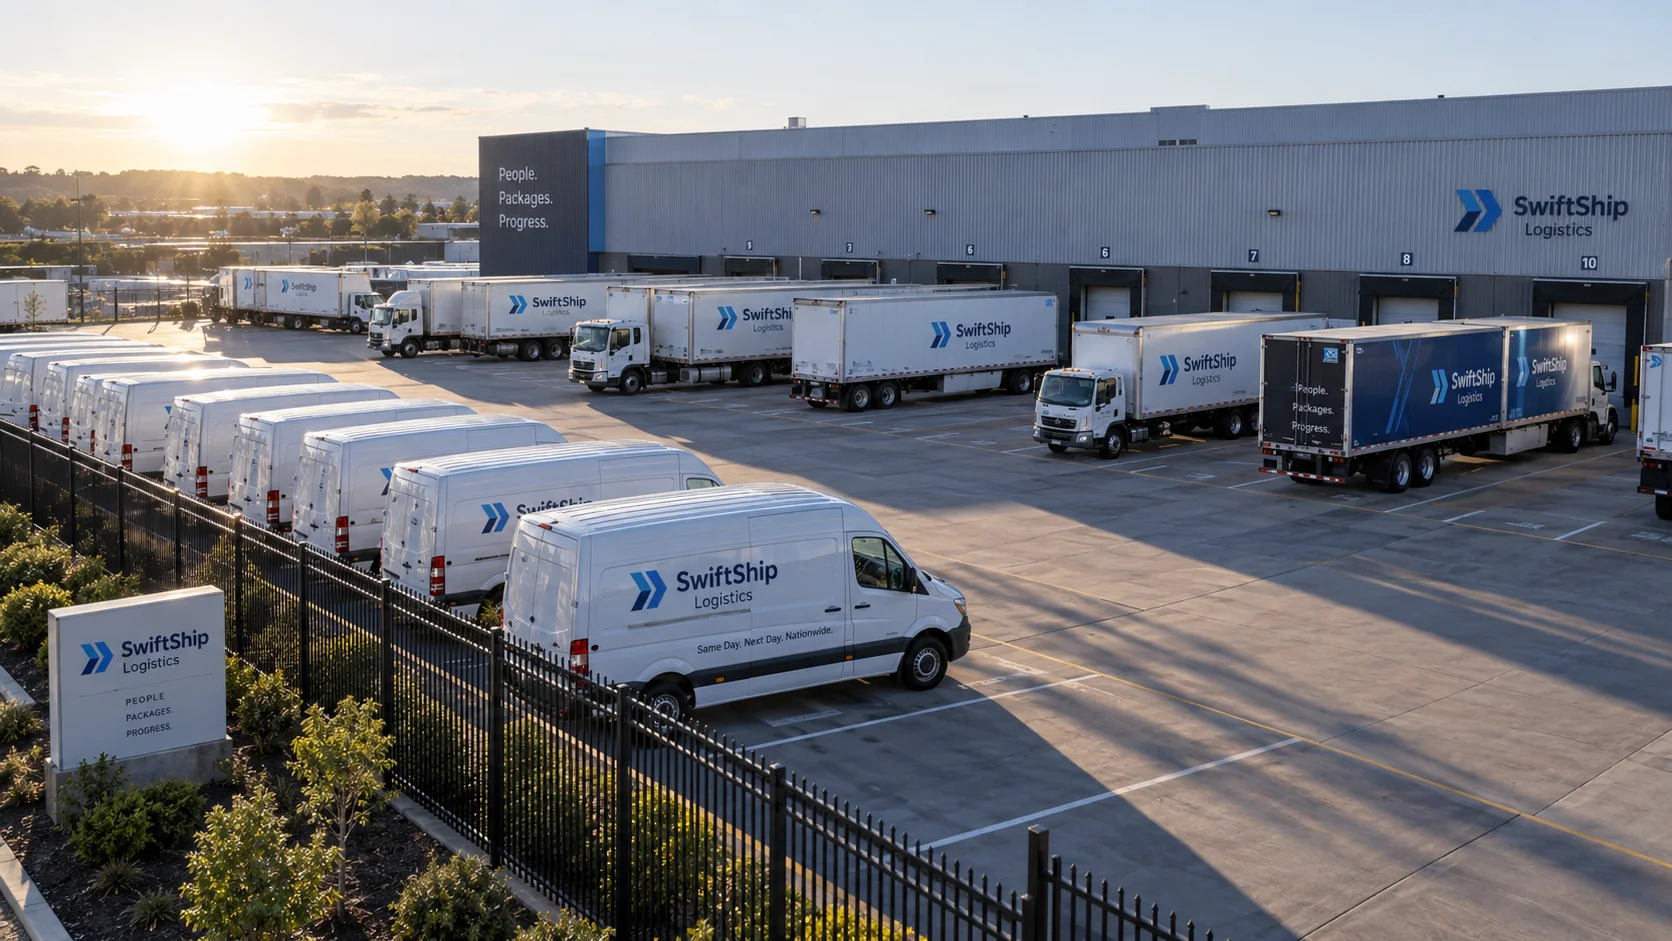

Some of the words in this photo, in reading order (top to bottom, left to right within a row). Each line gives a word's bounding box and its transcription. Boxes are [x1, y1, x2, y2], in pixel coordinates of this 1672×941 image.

[499, 166, 537, 184] People.
[499, 190, 553, 208] Packages.
[1514, 194, 1629, 221] SwiftShip
[499, 213, 549, 231] Progress.
[1525, 222, 1593, 239] Logistics
[967, 245, 973, 255] 6
[1102, 248, 1108, 257] 6
[1250, 251, 1257, 261] 7
[1403, 253, 1410, 264] 8
[1582, 257, 1597, 269] 10
[532, 296, 587, 308] SwiftShip
[742, 307, 793, 321] SwiftShi
[753, 324, 784, 334] Logistics
[956, 321, 1011, 338] SwiftShip
[965, 340, 996, 351] Logistics
[1184, 352, 1237, 372] SwiftShip
[1532, 356, 1567, 375] SwiftShip
[1192, 374, 1221, 387] Logistics
[1451, 367, 1496, 389] SwiftShip
[1298, 384, 1328, 396] People.
[1457, 391, 1483, 406] Logistics
[1292, 402, 1335, 416] Packages.
[1291, 421, 1330, 434] Progress.
[676, 560, 778, 592] SwiftShip
[694, 590, 753, 610] Logistics
[121, 629, 209, 658] SwiftShip
[697, 644, 722, 654] Same
[723, 640, 742, 651] Day.
[744, 637, 764, 647] Next
[766, 634, 784, 645] Day.
[785, 626, 834, 641] Nationwide.
[123, 656, 180, 674] Logistics
[125, 692, 165, 706] PEOPLE
[126, 707, 175, 722] PACKAGES.
[126, 723, 173, 738] PROGRESS.
